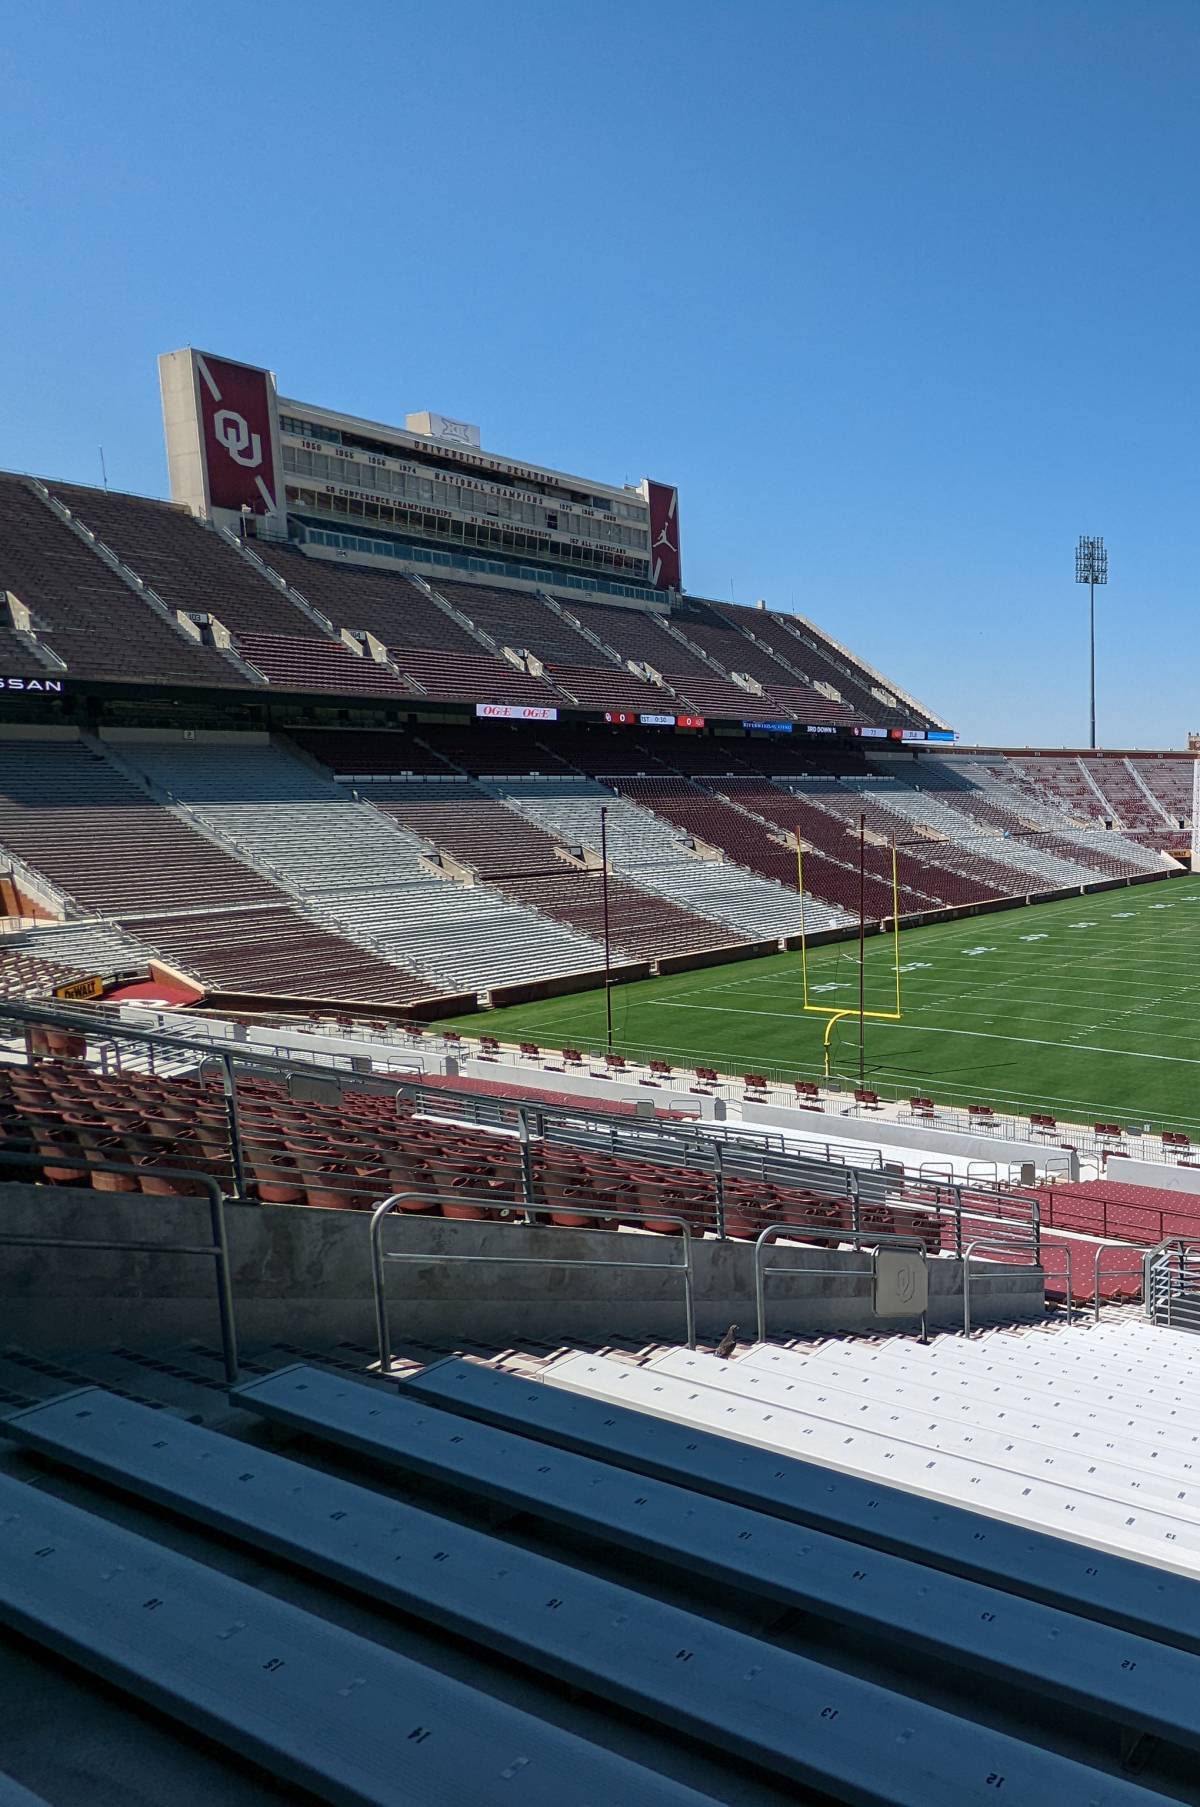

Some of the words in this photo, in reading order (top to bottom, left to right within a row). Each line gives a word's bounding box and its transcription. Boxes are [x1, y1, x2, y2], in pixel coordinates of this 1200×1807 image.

[214, 409, 263, 467] OU
[414, 441, 484, 466] UNIVERSITY
[490, 461, 502, 470] OF
[507, 465, 559, 486] OKLAHOMA
[339, 488, 390, 505] CONFERENCE
[393, 500, 452, 518] CHAMPIONSHIPS
[434, 472, 485, 491] NATIONAL
[490, 486, 543, 505] CHAMPIONS
